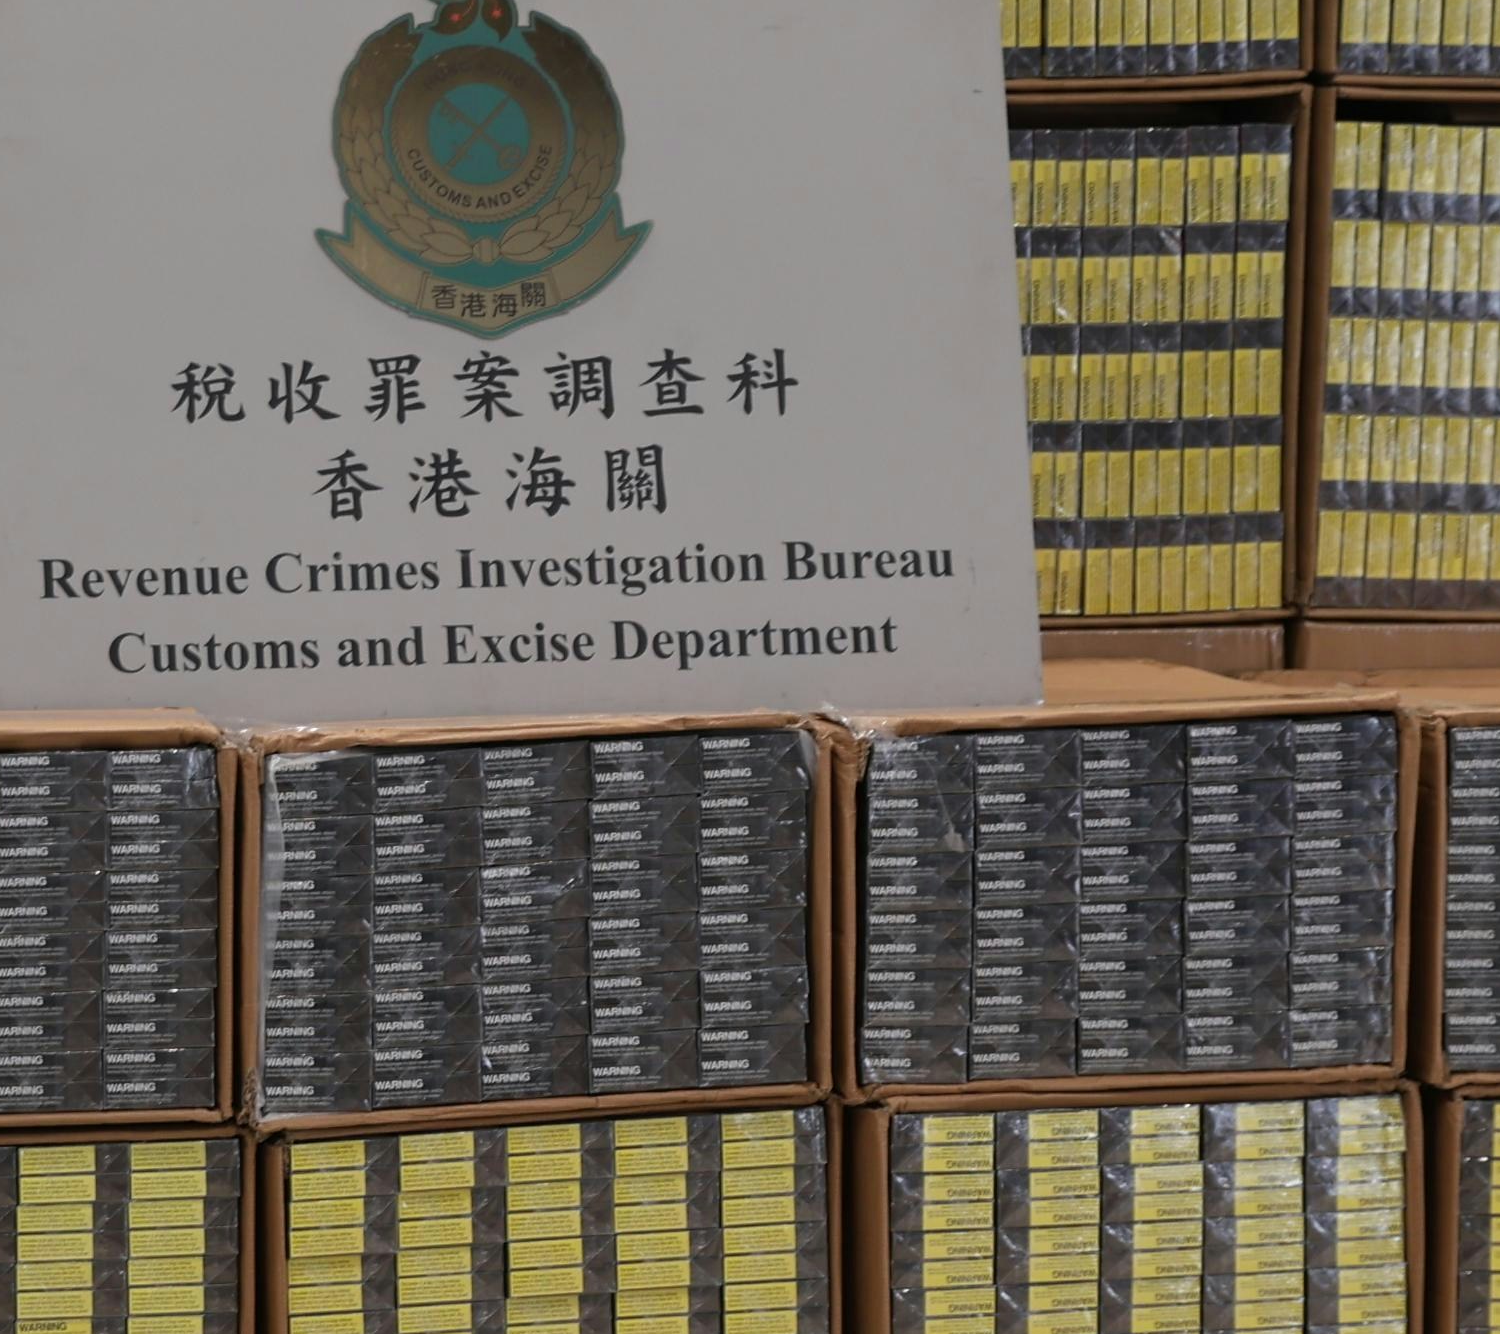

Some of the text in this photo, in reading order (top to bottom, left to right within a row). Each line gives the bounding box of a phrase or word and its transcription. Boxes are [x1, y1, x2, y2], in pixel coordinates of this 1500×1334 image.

[407, 144, 553, 209] CUSTOMS AND EXCISE
[432, 282, 547, 318] 香港海關
[170, 348, 799, 424] 稅收罪案調查科
[312, 444, 668, 522] 香港海關
[39, 541, 953, 599] Revenue Crimes Investigation Bureau
[108, 618, 898, 674] Customs and Excise Department
[1, 756, 50, 767] WARNING
[704, 767, 751, 779] WARNING
[1083, 788, 1129, 799] WARNING
[0, 817, 48, 828] WARNING
[375, 814, 422, 826] WARNING
[485, 836, 532, 848] WARNING
[594, 830, 641, 842] WARNING
[376, 844, 423, 856] WARNING
[1082, 845, 1128, 856] WARNING
[1190, 842, 1236, 853] WARNING
[978, 850, 1024, 861] WARNING
[1190, 871, 1236, 882] WARNING
[1188, 900, 1234, 911] WARNING
[1294, 895, 1340, 906] WARNING
[977, 908, 1023, 919] WARNING
[1080, 903, 1126, 914] WARNING
[592, 918, 639, 930] WARNING
[870, 913, 916, 924] WARNING
[593, 947, 640, 959] WARNING
[701, 942, 748, 954] WARNING
[483, 954, 530, 966] WARNING
[1186, 958, 1232, 969] WARNING
[1292, 953, 1338, 964] WARNING
[375, 961, 422, 973] WARNING
[976, 966, 1022, 977] WARNING
[868, 971, 914, 982] WARNING
[595, 1005, 642, 1017] WARNING
[704, 1000, 751, 1012] WARNING
[973, 1023, 1019, 1034] WARNING
[593, 1065, 640, 1077] WARNING
[375, 1078, 422, 1090] WARNING
[482, 1072, 529, 1084] WARNING
